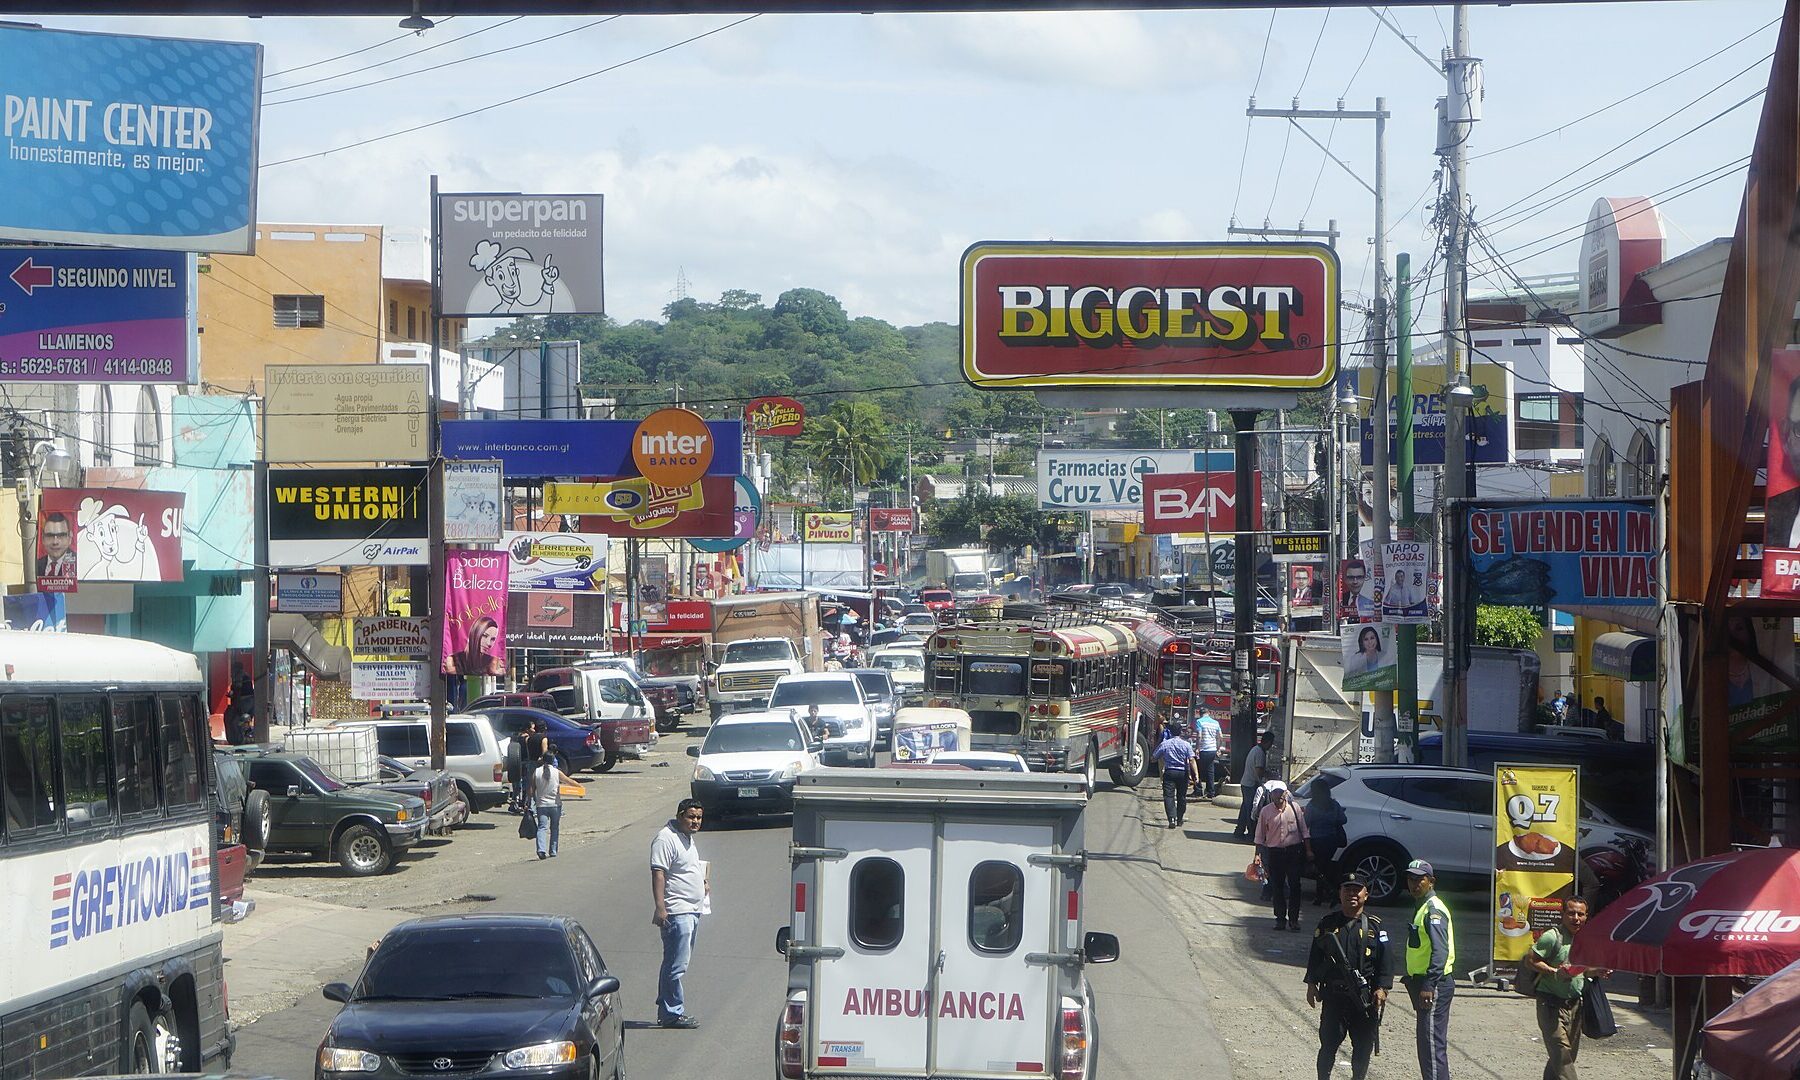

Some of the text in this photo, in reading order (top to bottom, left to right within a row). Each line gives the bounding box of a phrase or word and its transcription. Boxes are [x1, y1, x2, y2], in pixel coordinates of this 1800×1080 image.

[4, 94, 213, 150] PAINT CENTER
[9, 139, 205, 175] honestamente, es mejor.
[454, 197, 587, 227] superpan
[492, 228, 587, 239] un pedacito de felicidad
[57, 267, 176, 288] SEGUNDO NIVEL
[998, 284, 1297, 343] BIGGEST
[39, 333, 114, 350] LLAMENOS
[20, 358, 89, 375] 5629-6781
[104, 358, 172, 375] 4114-0848
[269, 368, 424, 387] Invierta con seguridad
[353, 393, 373, 403] propia
[356, 404, 398, 412] Pavimentadas
[641, 431, 707, 455] inter
[445, 463, 501, 473] Pet-Wash
[650, 457, 698, 466] BANCO
[1048, 459, 1126, 477] Farmacias
[275, 486, 398, 503] WESTERN
[1049, 478, 1101, 503] Cruz
[315, 503, 398, 520] UNION
[808, 530, 849, 539] PINULITO
[1274, 537, 1319, 545] WESTERN
[1470, 510, 1657, 555] SE VENDEN M
[383, 546, 419, 556] AirPak
[533, 544, 591, 552] FERRETERIA
[1386, 543, 1420, 554] NAPO
[459, 551, 499, 568] Salón
[1392, 553, 1425, 562] ROJAS
[453, 573, 503, 591] Belleza
[362, 618, 421, 637] BARBERIA
[506, 632, 604, 642] ugar ideal para compartir
[1728, 701, 1782, 724] nidades!
[71, 851, 190, 941] GREYHOUND
[1679, 909, 1800, 940] Gallo
[831, 1044, 862, 1053] TRANSAM
